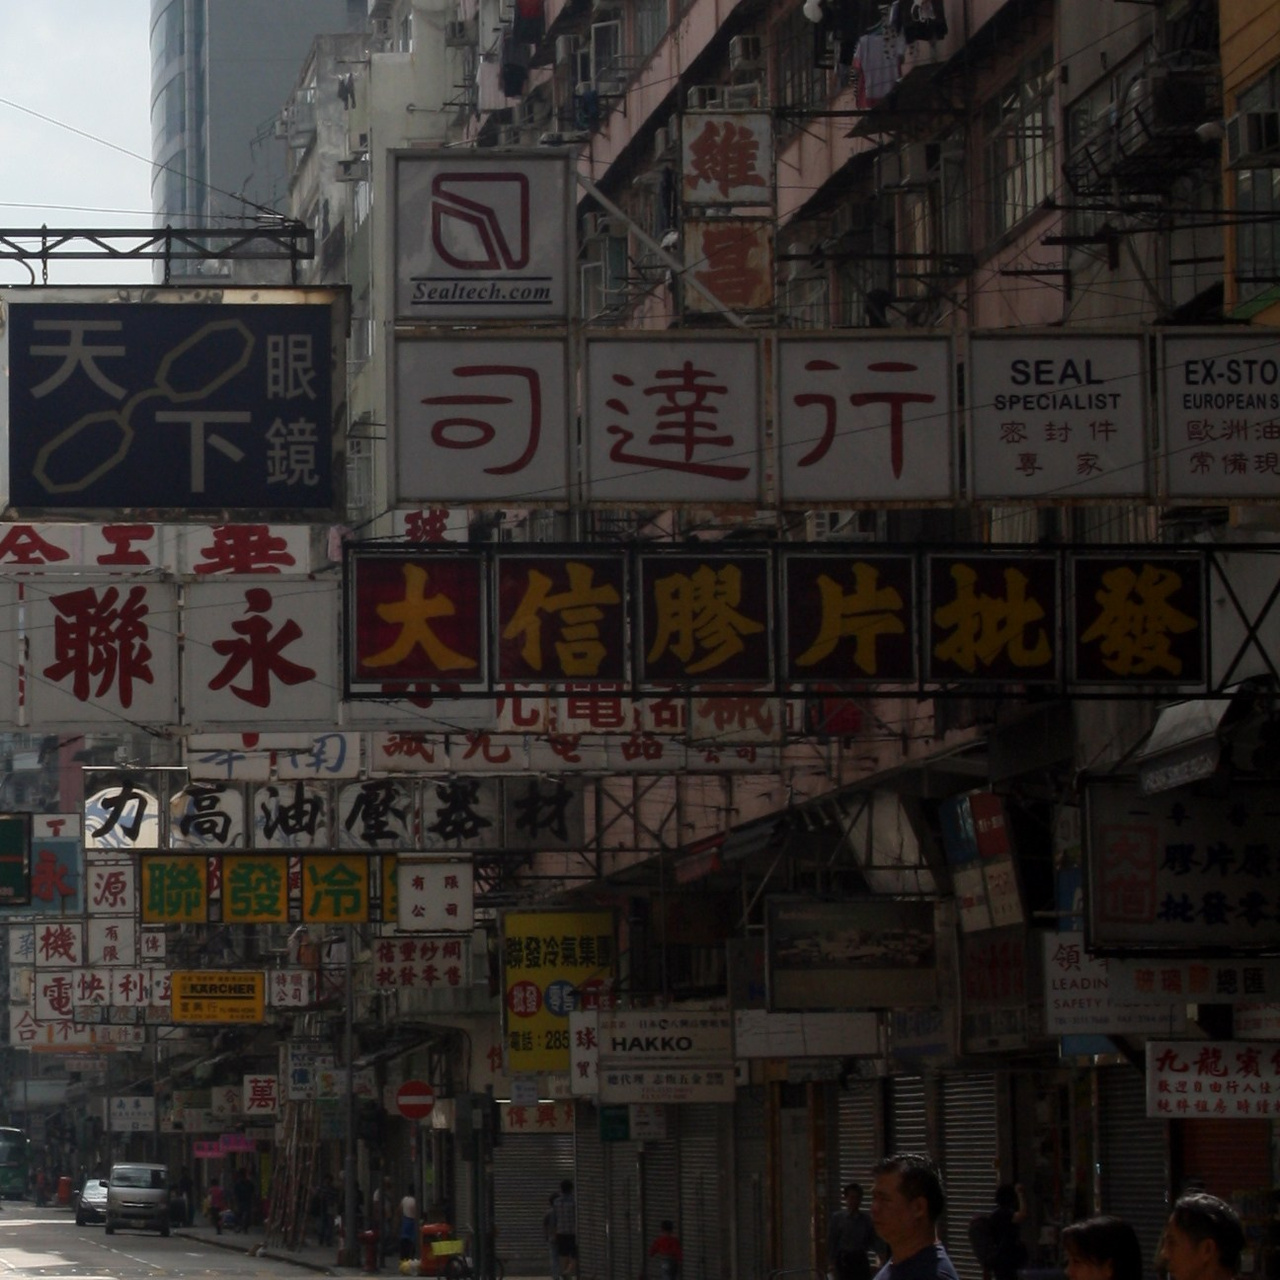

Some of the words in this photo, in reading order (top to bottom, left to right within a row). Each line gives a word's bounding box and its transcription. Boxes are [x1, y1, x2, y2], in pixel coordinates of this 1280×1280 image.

[413, 281, 551, 301] Sealtech.com
[1010, 359, 1104, 386] SEAL
[994, 394, 1122, 411] SPECIALIST
[1183, 393, 1266, 410] EUROPEAN
[361, 562, 1199, 678] 大信膠片批發
[612, 1036, 693, 1051] HAKKO
